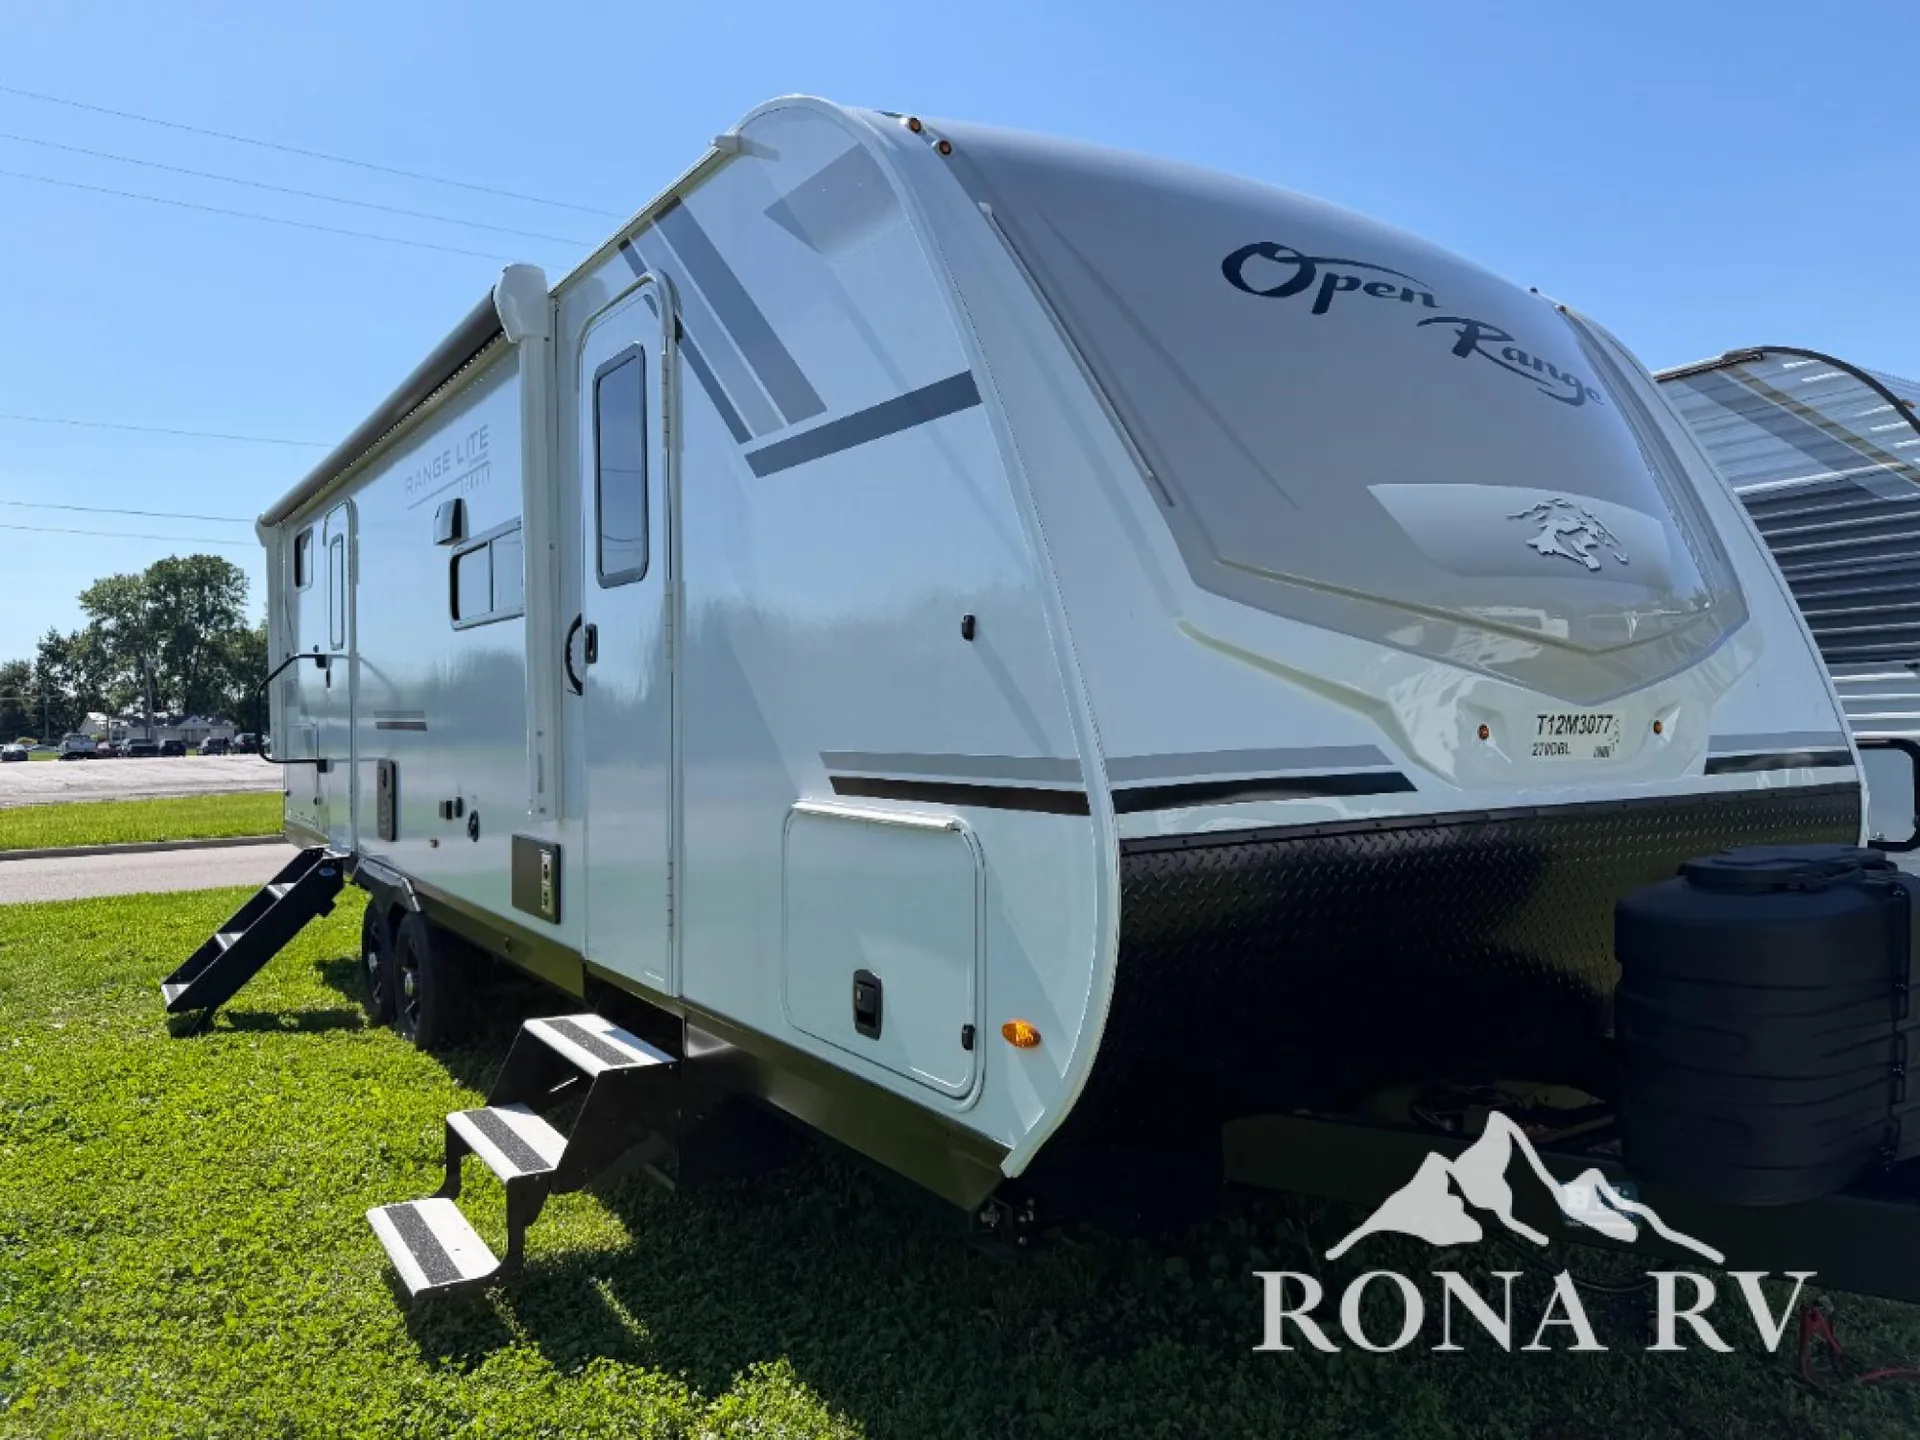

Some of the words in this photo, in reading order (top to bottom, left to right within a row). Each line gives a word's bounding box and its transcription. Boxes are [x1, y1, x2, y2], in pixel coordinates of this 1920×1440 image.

[1221, 241, 1441, 315] Open
[1417, 316, 1605, 407] Range
[405, 449, 451, 496] RANGE
[457, 424, 490, 465] LITE
[1537, 713, 1613, 736] T12M3077
